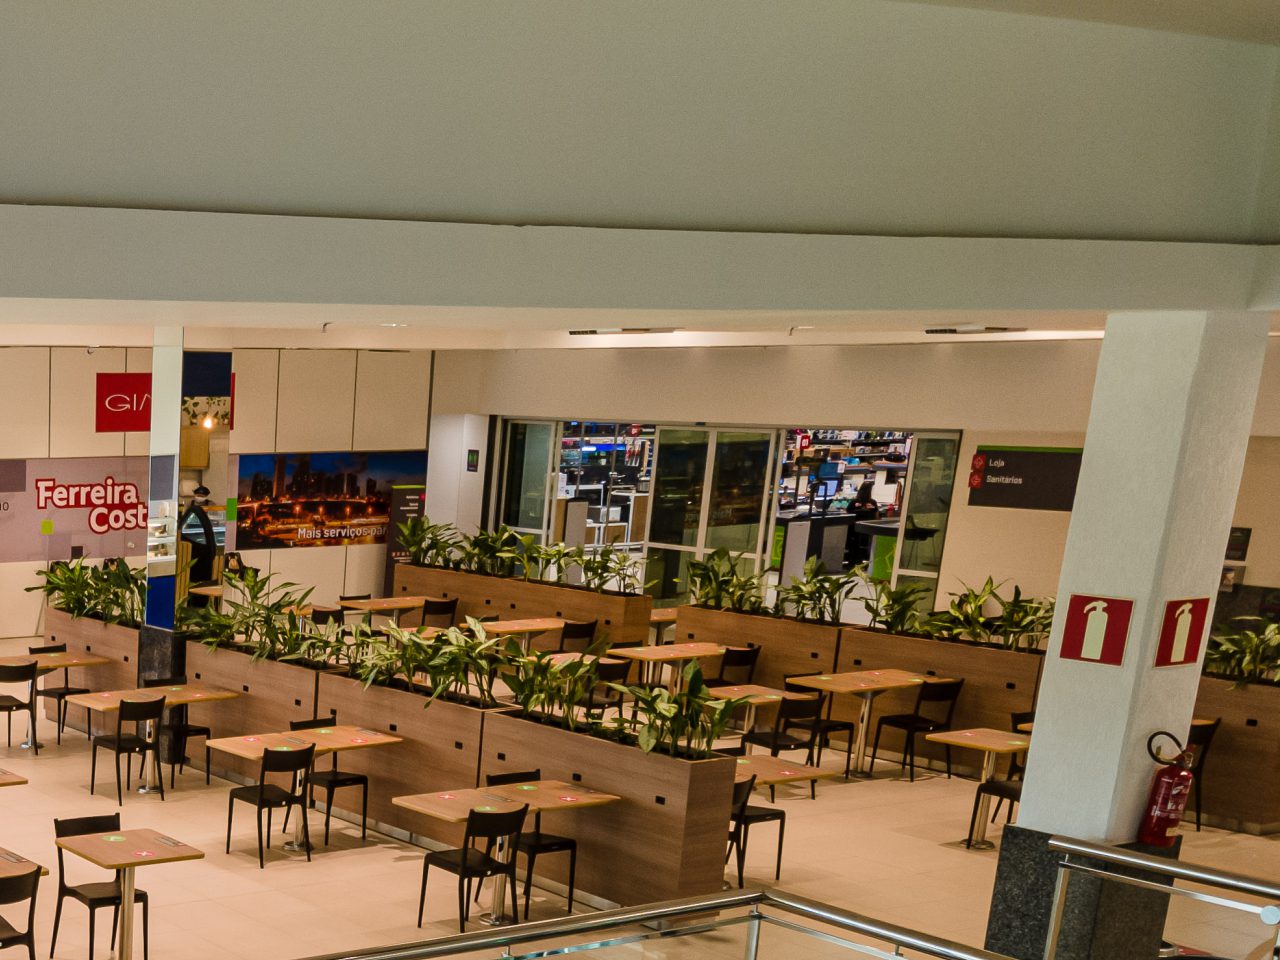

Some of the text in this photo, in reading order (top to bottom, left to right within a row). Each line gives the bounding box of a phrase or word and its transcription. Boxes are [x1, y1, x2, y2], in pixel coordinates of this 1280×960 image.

[989, 458, 1005, 468] Loja
[986, 474, 1023, 484] Sanitários
[36, 477, 138, 509] Ferreira
[89, 504, 148, 534] Cost
[297, 525, 387, 540] Mais serviços par
